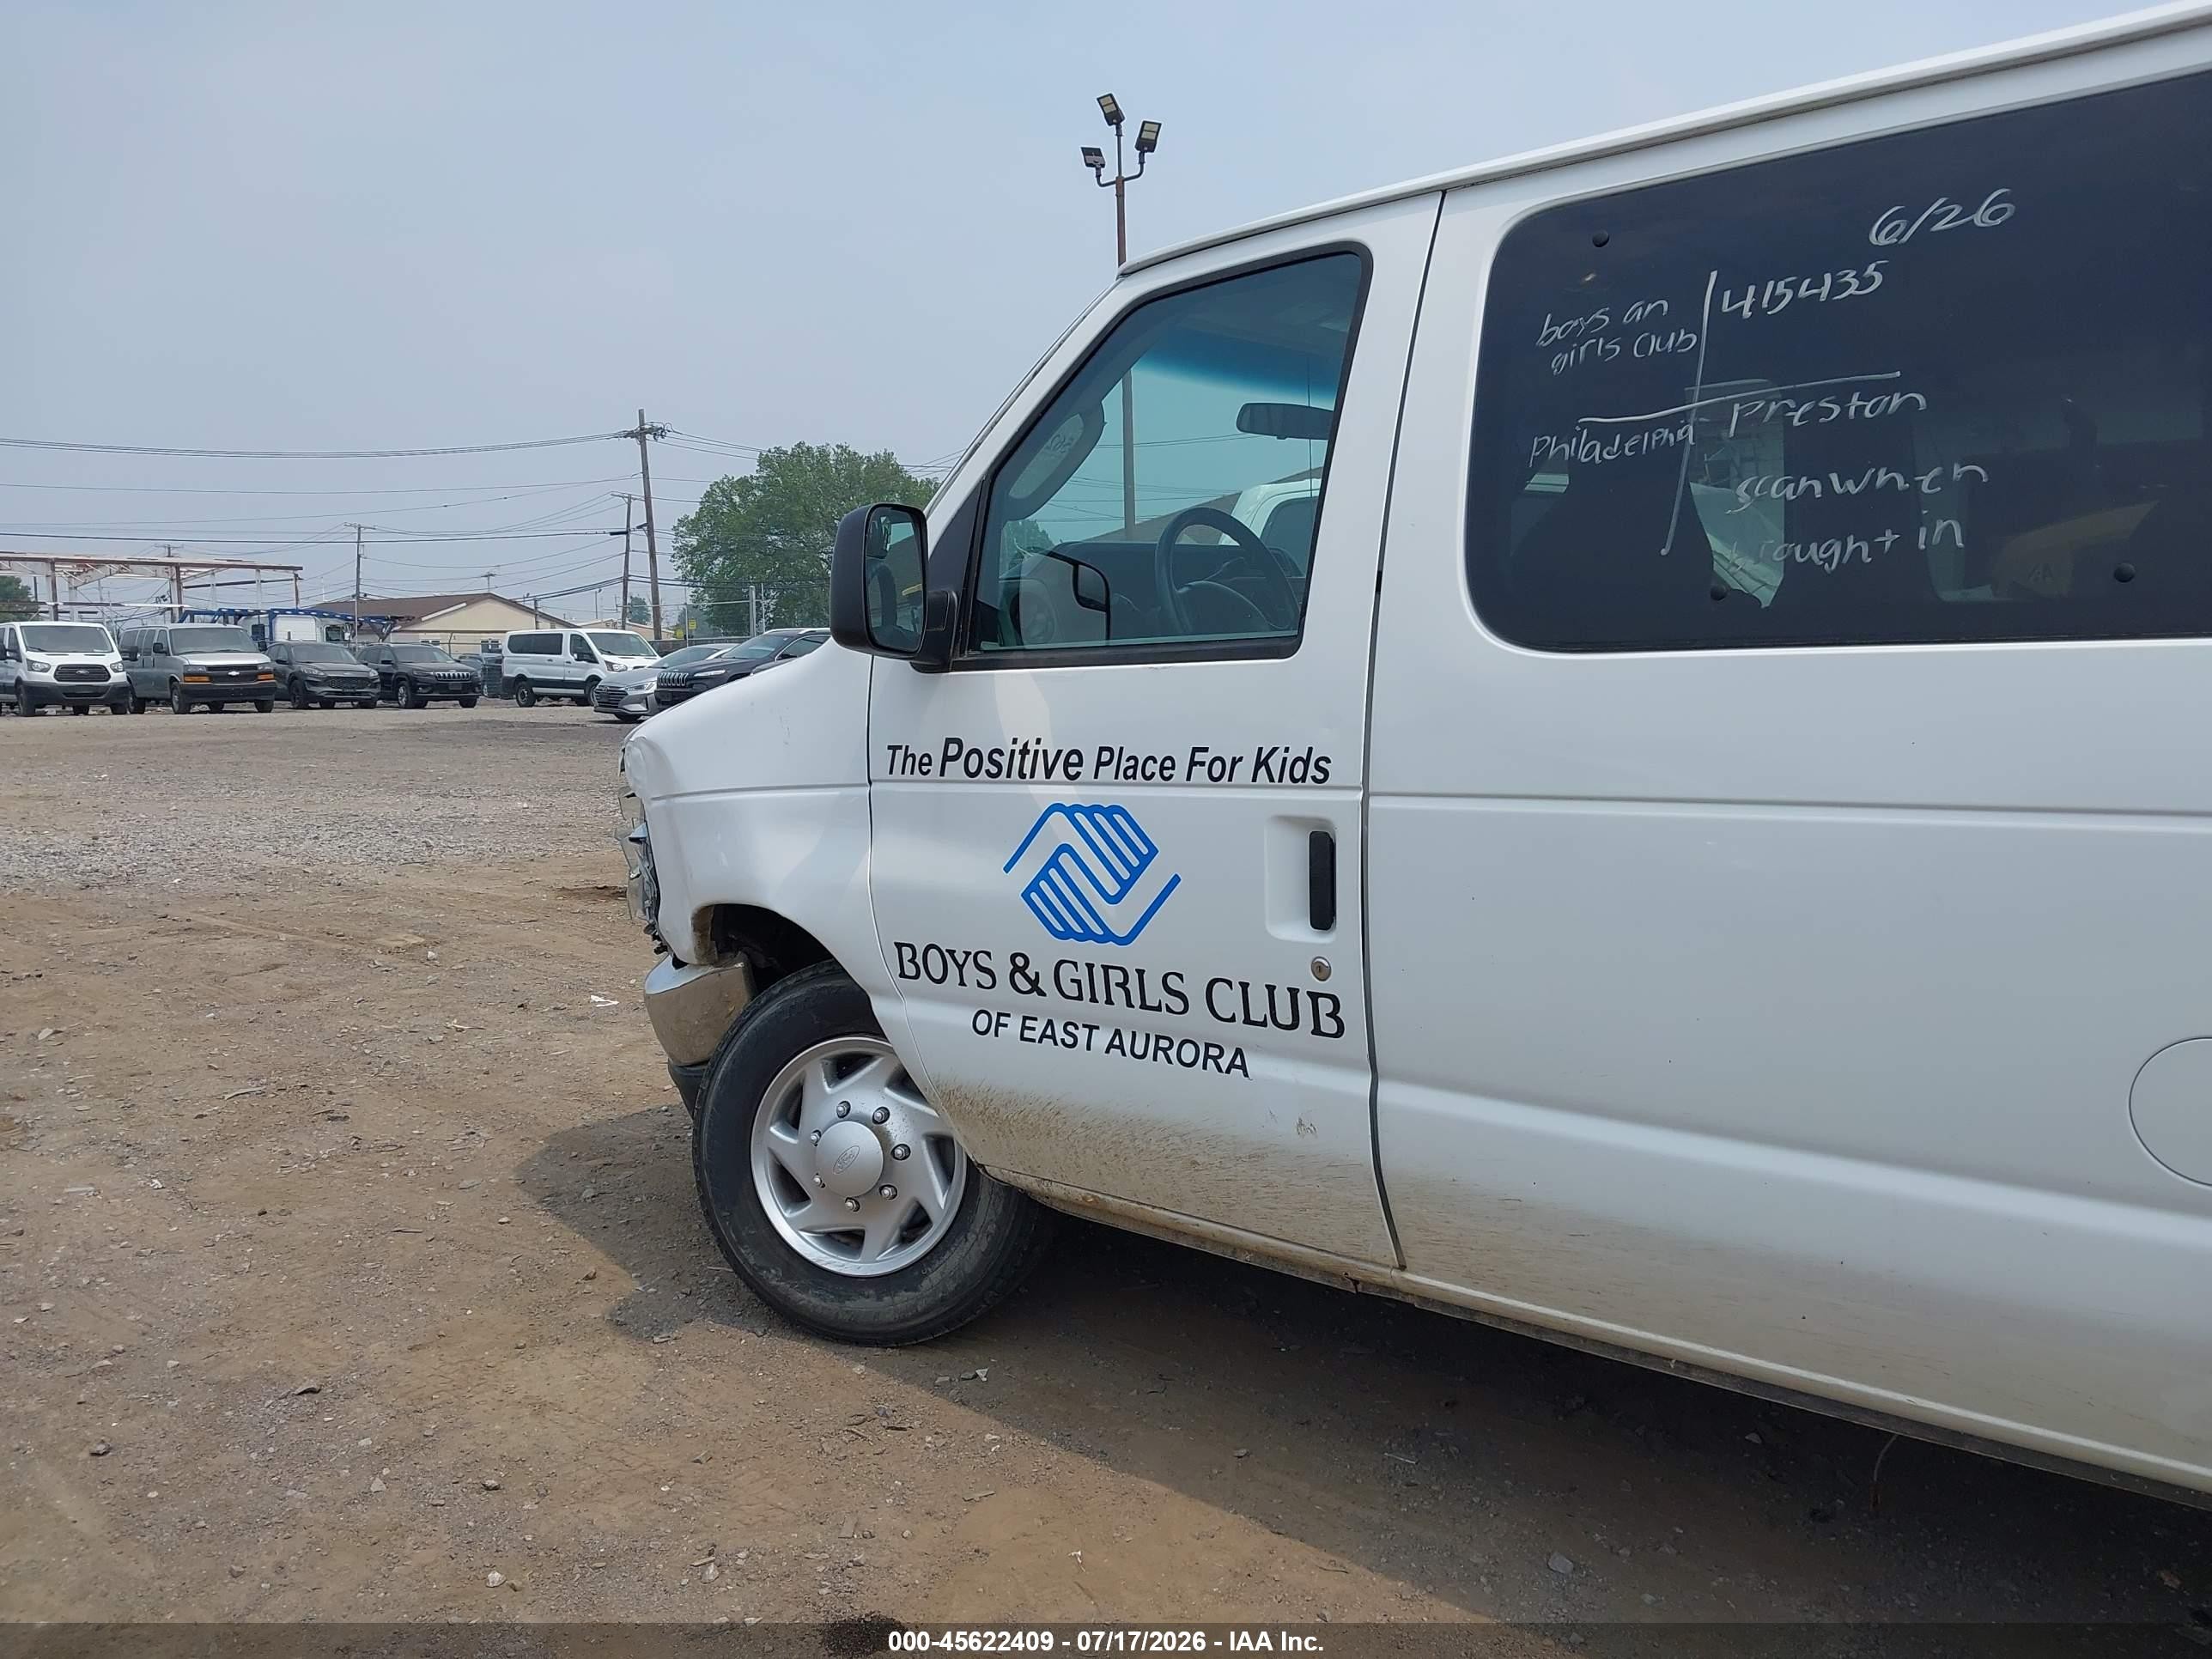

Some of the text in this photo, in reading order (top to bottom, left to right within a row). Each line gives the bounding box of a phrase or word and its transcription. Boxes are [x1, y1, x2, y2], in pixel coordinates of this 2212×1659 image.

[1869, 187, 2015, 246] 6/26
[1722, 260, 1889, 319] 415435
[1535, 307, 1610, 347] boys
[1918, 509, 1964, 550] in
[886, 737, 1332, 784] The Positive Place For Kids
[893, 941, 1346, 1040] BOYS & GIRLS CLUB
[971, 1009, 1251, 1079] OF EAST AURORA
